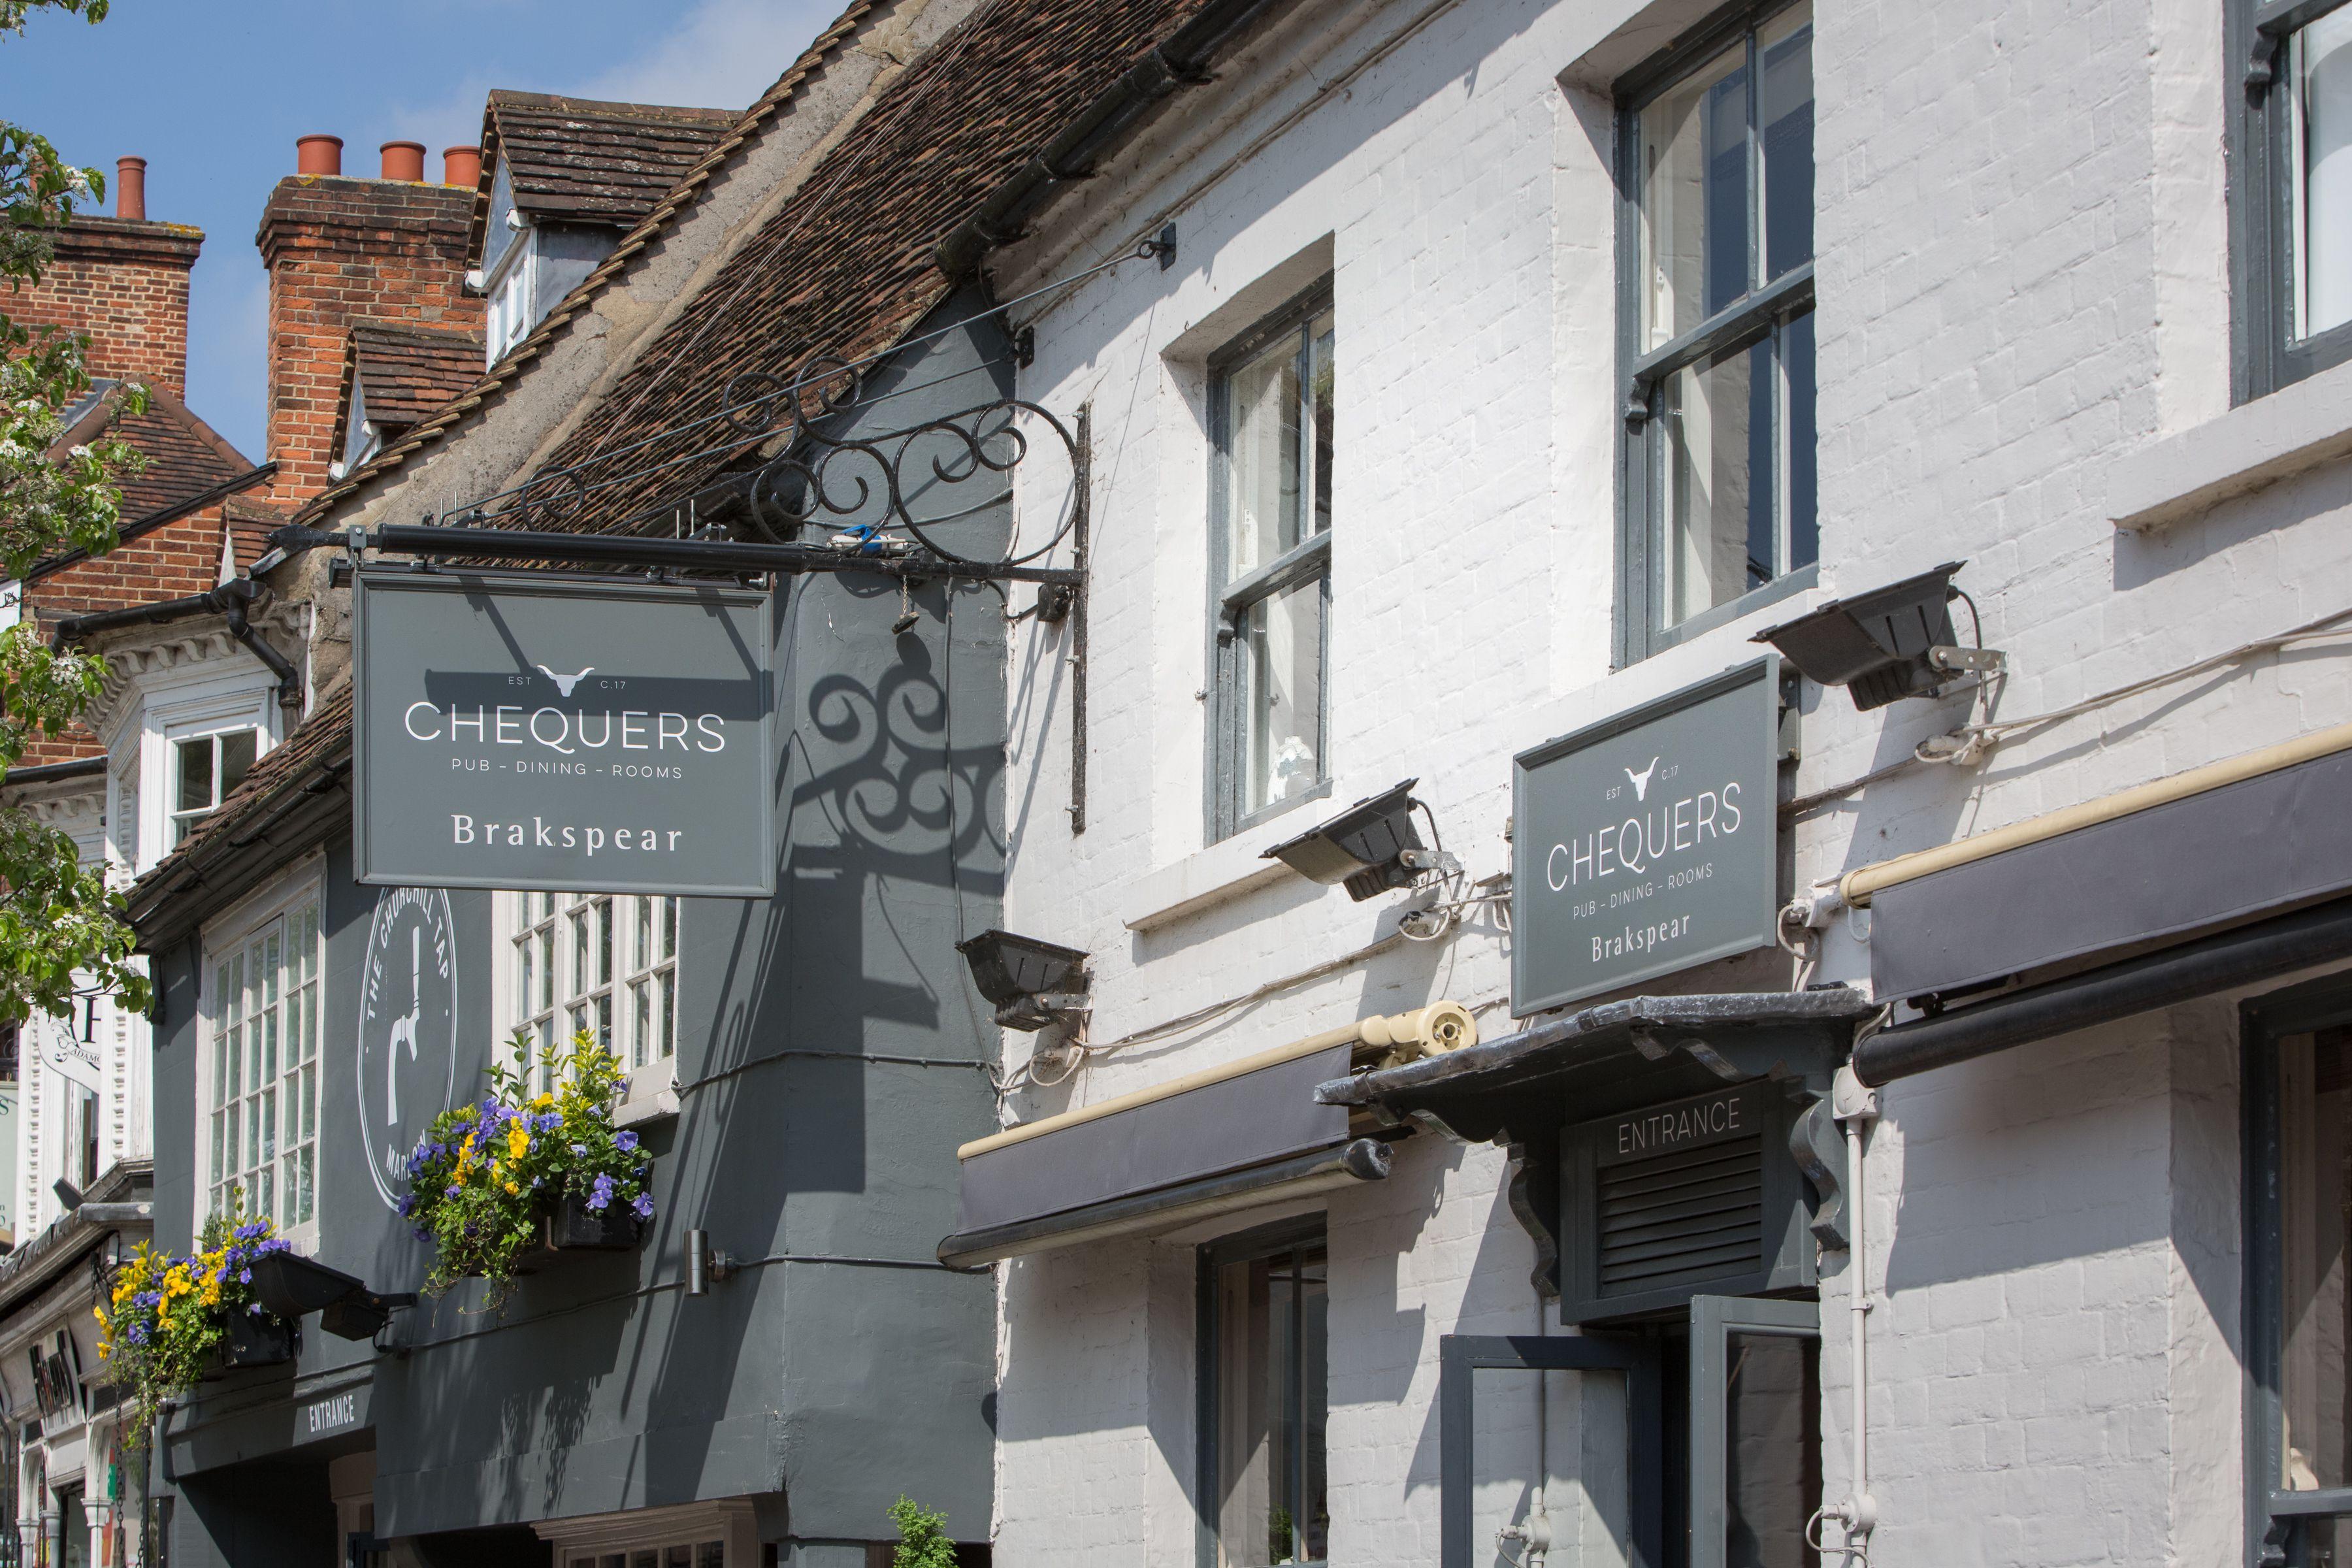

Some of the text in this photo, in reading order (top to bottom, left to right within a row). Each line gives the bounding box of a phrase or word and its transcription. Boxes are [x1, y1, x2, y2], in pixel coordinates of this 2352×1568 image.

[508, 676, 626, 690] EST C.17
[404, 701, 725, 755] CHEQUERS
[452, 758, 489, 772] PUB
[517, 760, 586, 775] DINING
[613, 764, 681, 779] ROOMS
[1607, 764, 1678, 800] EST C.17
[451, 815, 682, 857] Brakspear
[1546, 782, 1742, 892] CHEQUERS
[1573, 900, 1595, 920] PUB
[1610, 882, 1652, 908] DINING
[1668, 862, 1712, 890] ROOMS
[1592, 915, 1691, 962] Brakspear
[367, 954, 383, 1021] THE
[434, 915, 449, 979] TAP
[1619, 1098, 1740, 1154] ENTRANCE
[309, 1394, 354, 1433] ENTRANCE
